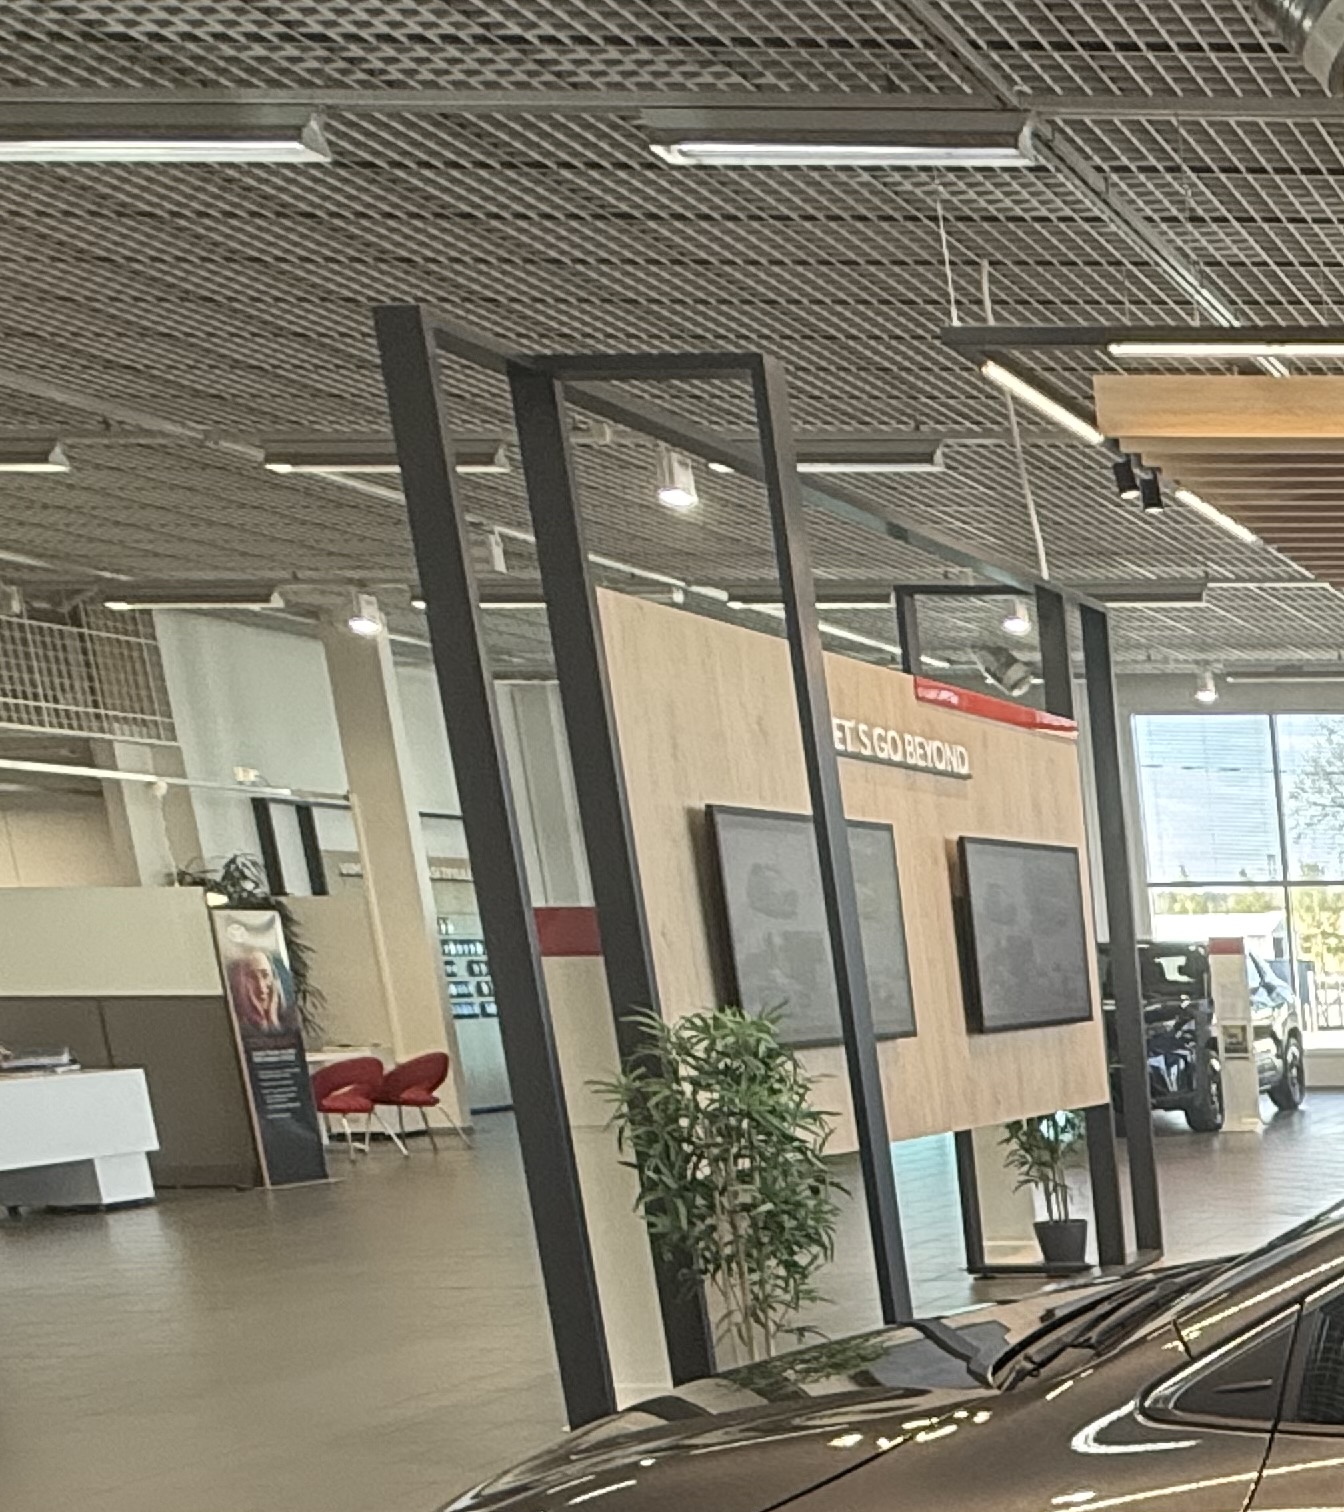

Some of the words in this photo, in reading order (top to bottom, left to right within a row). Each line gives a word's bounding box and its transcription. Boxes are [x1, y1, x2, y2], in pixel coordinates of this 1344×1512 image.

[832, 716, 873, 755] ET'S
[873, 726, 902, 761] GO
[903, 732, 970, 774] BEYOND
